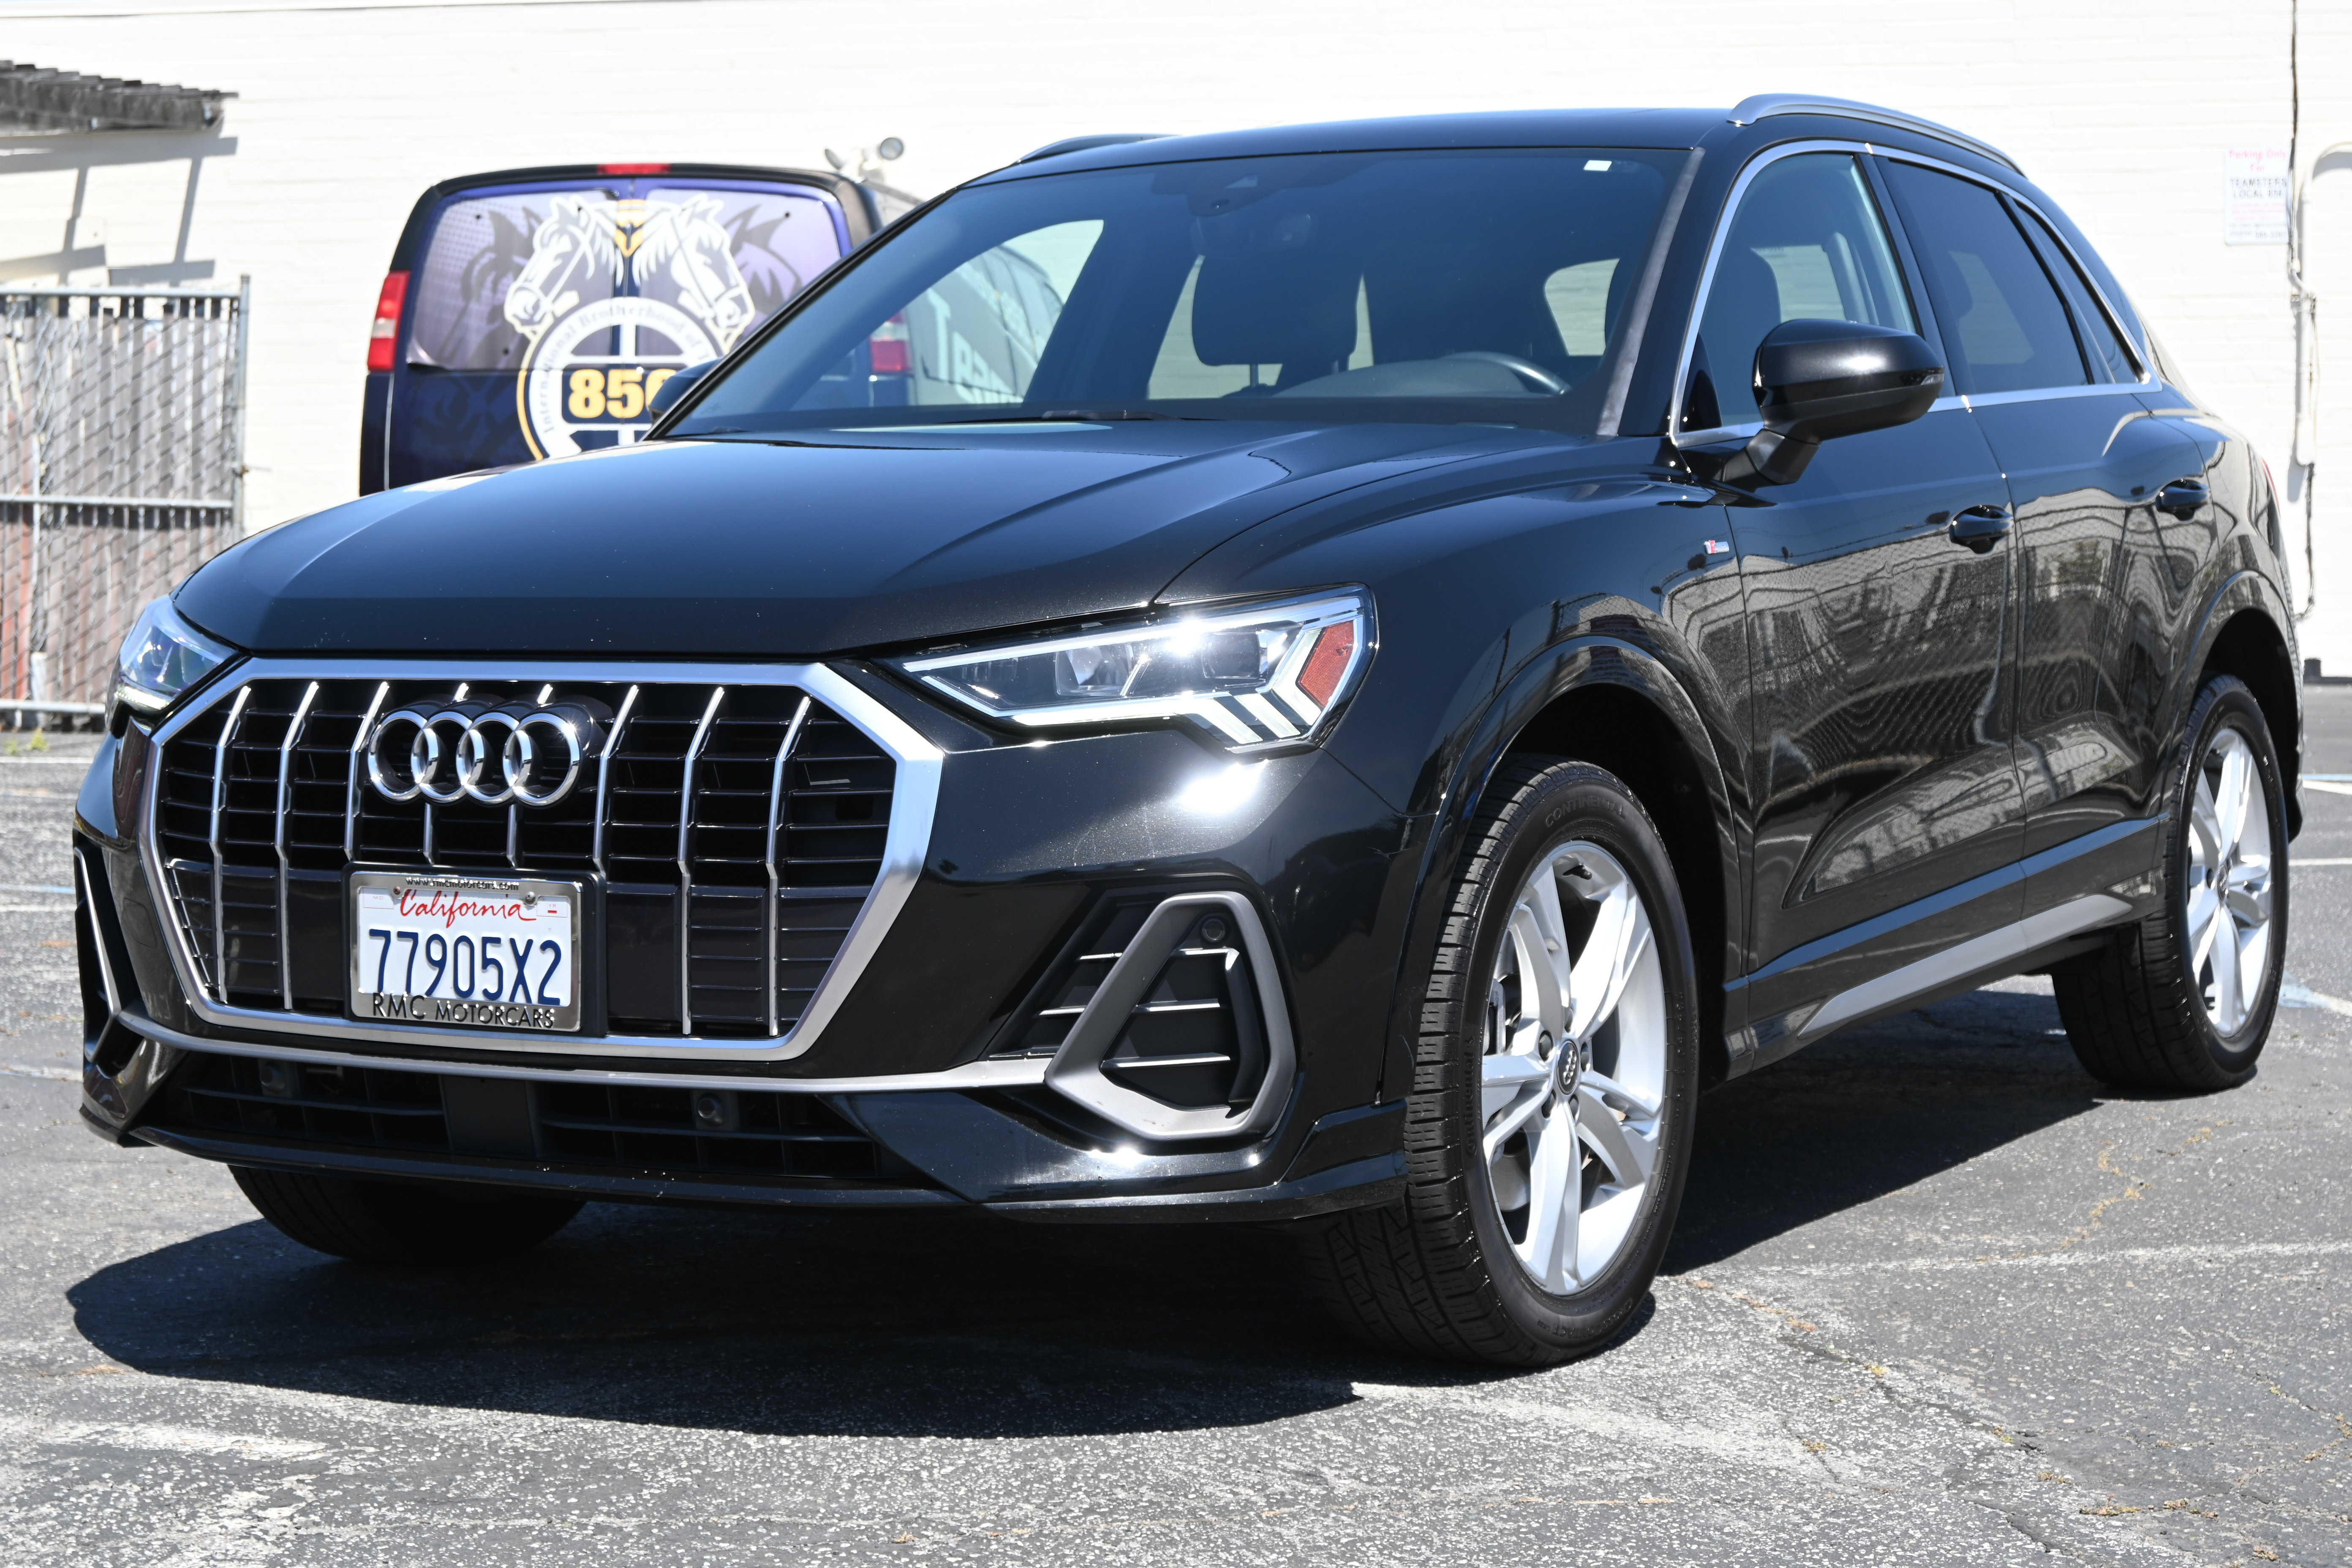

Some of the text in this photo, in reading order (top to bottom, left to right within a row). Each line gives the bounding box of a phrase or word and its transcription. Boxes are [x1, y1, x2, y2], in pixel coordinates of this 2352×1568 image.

[2229, 149, 2287, 160] Parking Only
[2250, 164, 2265, 172] For
[2230, 177, 2287, 188] TEAMSTERS
[2234, 190, 2264, 199] LOCAL
[579, 304, 685, 332] Brotherhood
[1546, 795, 1626, 828] CONTINENTAL
[400, 889, 536, 928] California
[369, 928, 562, 1005] 77905X2
[373, 993, 555, 1029] RMC MOTORCARS
